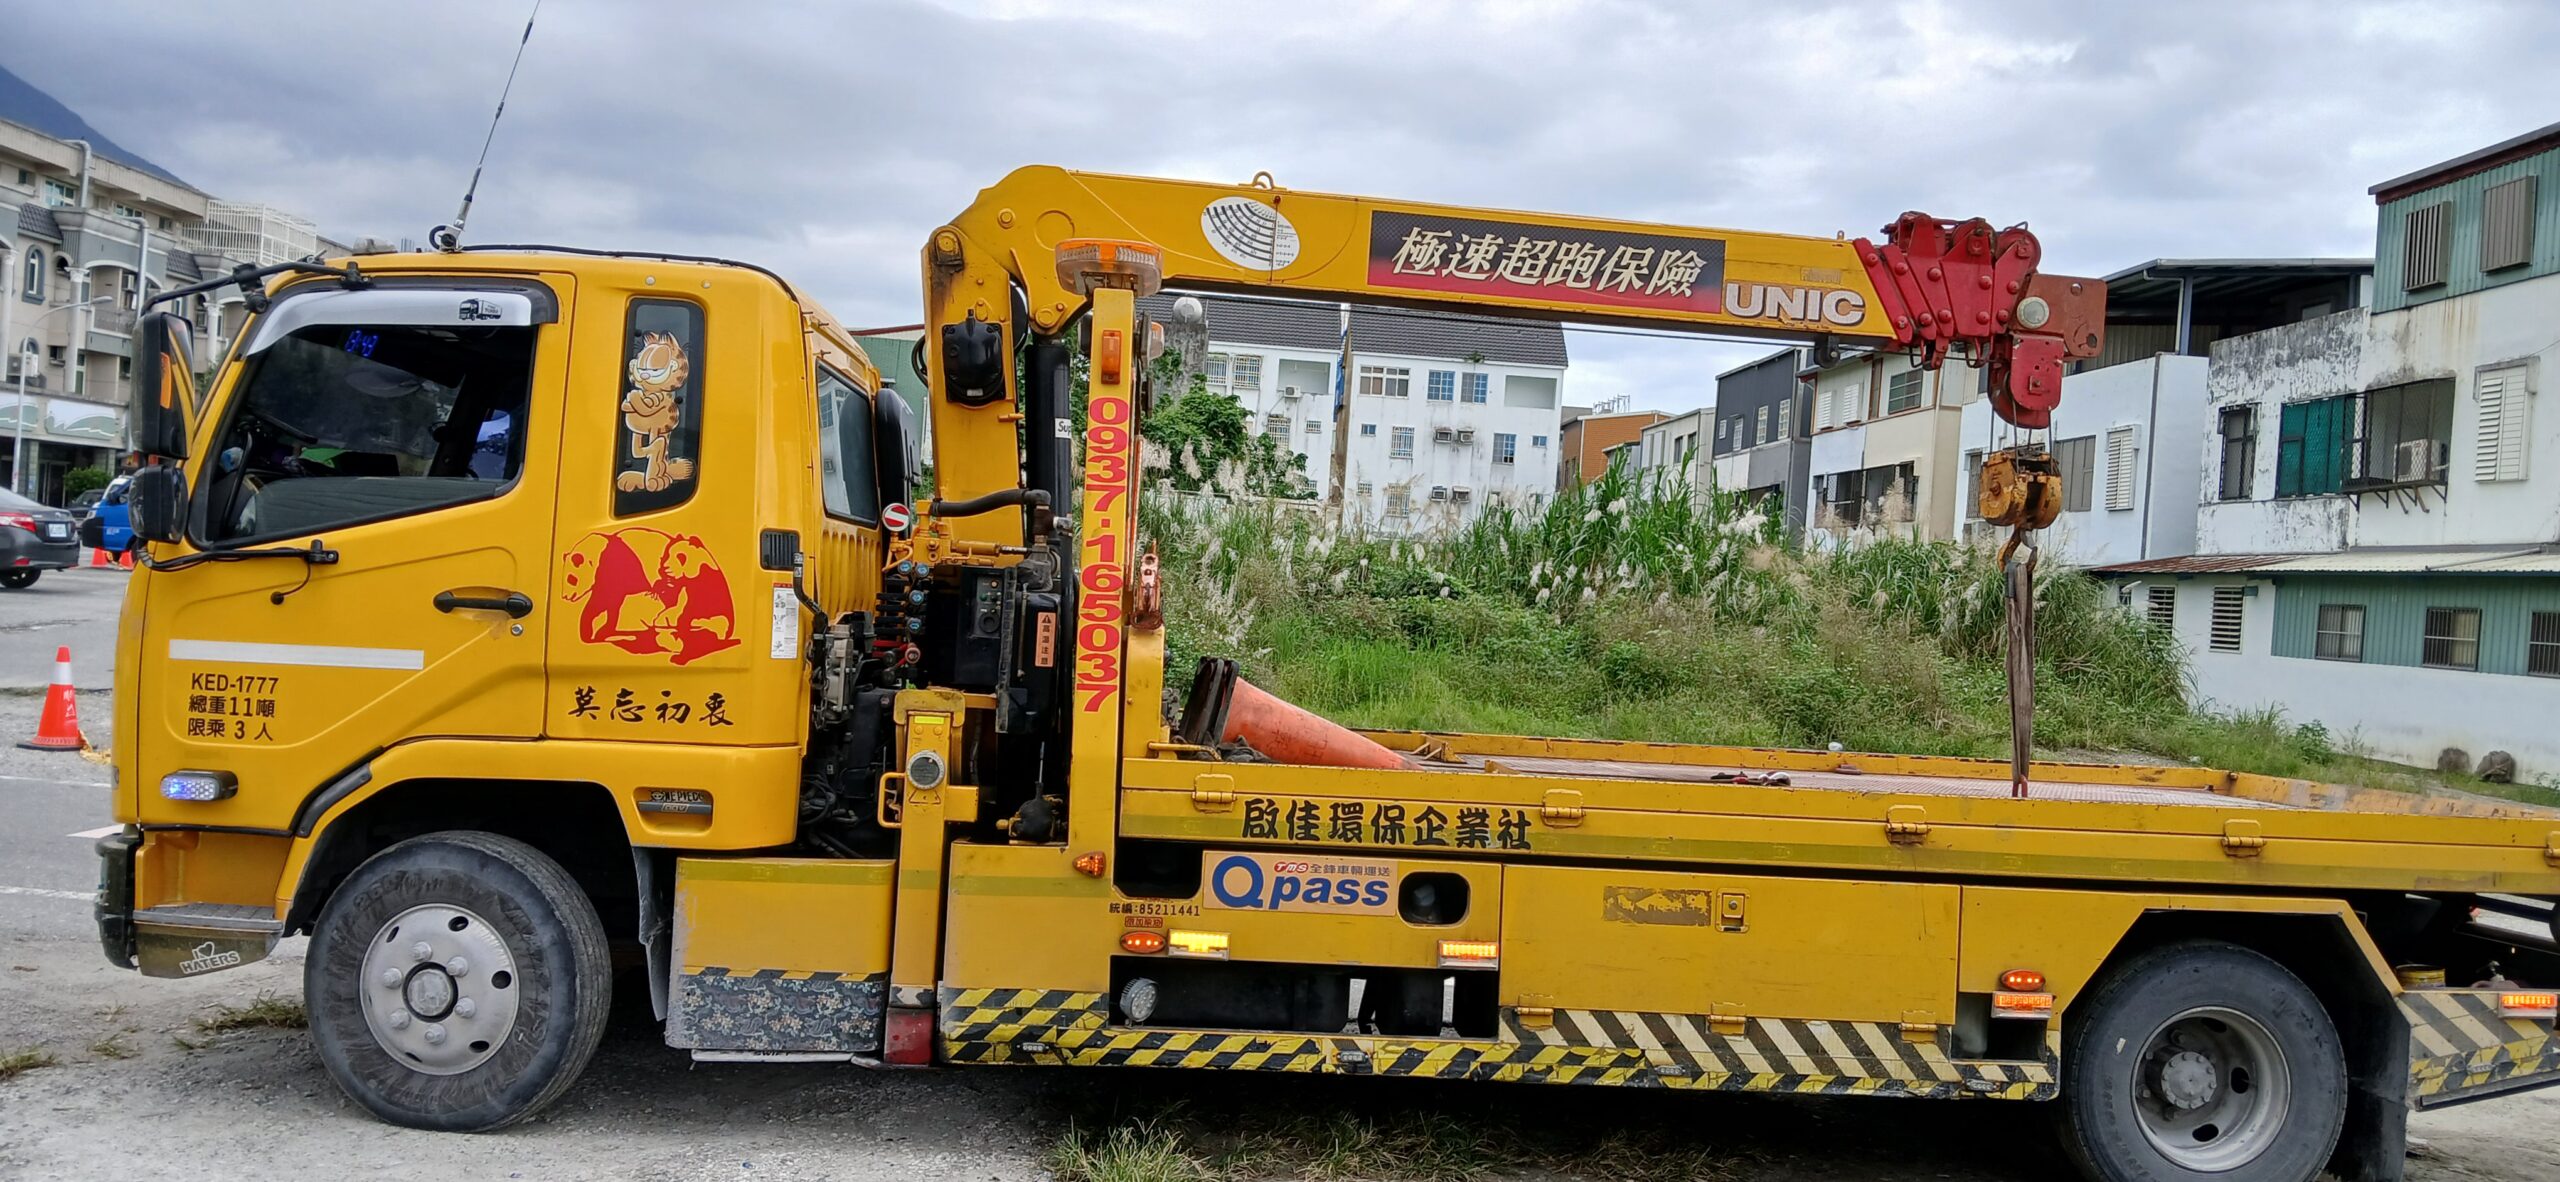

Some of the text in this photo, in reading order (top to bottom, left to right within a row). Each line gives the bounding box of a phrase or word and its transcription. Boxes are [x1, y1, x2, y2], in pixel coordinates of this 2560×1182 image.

[1391, 226, 1708, 298] 極速超跑保險
[1725, 282, 1867, 327] UNIC
[191, 672, 279, 694] KED-1777
[234, 720, 245, 740] 3
[254, 722, 274, 741] 人
[1241, 797, 1532, 850] 啟佳環保企業社
[1212, 855, 1390, 910] Qpass
[180, 951, 240, 974] HATERS
